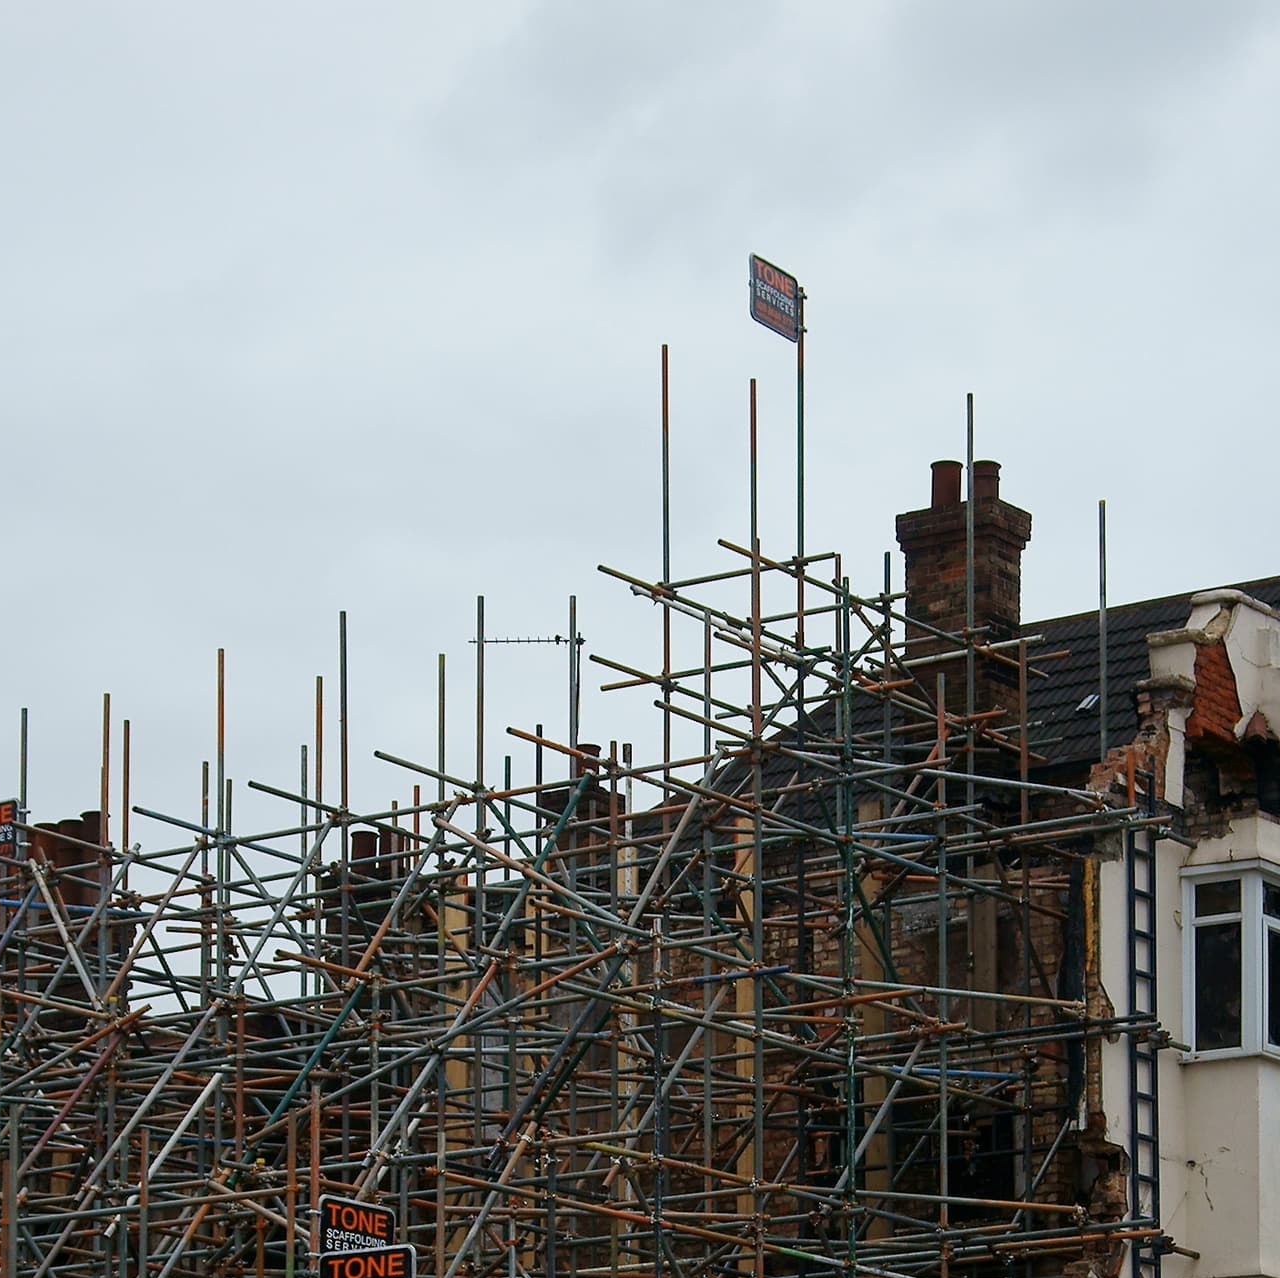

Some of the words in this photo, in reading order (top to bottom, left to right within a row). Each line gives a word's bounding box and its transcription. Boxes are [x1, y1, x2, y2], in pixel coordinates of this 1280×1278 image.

[754, 258, 794, 299] TONE
[327, 1204, 388, 1237] TONE
[326, 1228, 386, 1247] SCAFFOLDING
